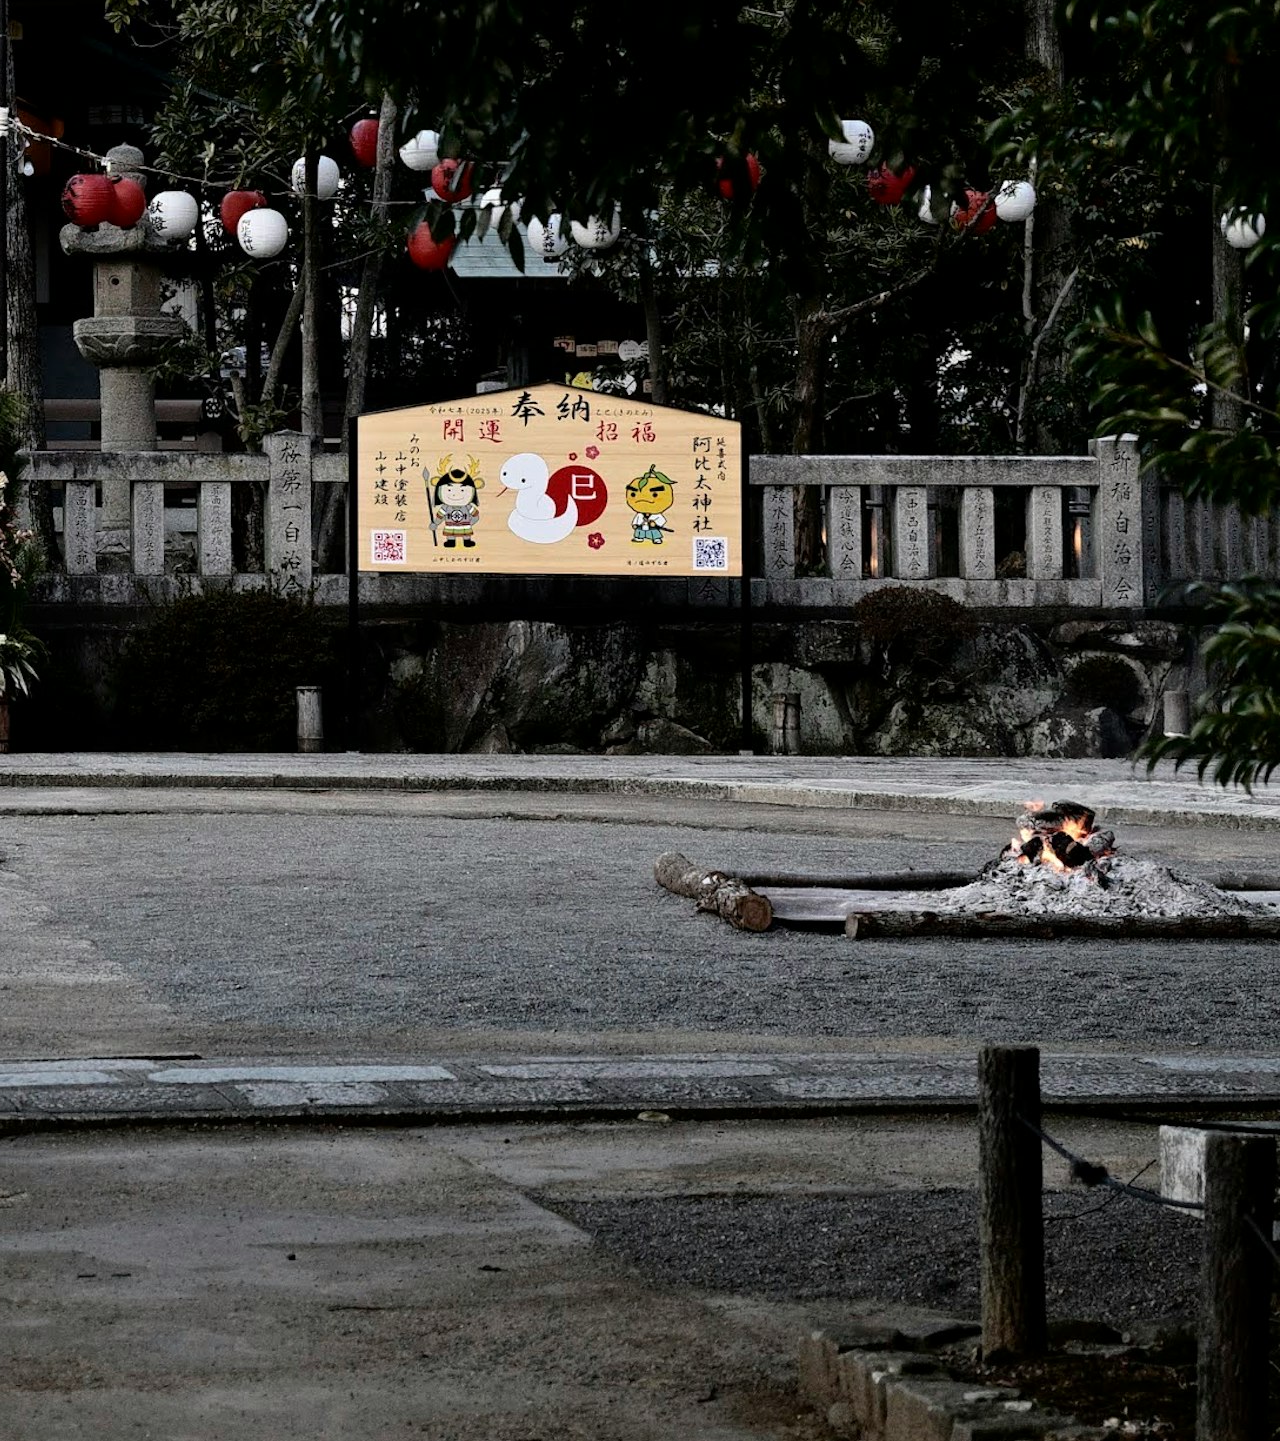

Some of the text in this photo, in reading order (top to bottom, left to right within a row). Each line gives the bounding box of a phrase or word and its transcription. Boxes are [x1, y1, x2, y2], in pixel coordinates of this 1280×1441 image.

[443, 419, 657, 443] 開運 招福
[510, 391, 591, 426] 奉納
[408, 433, 421, 469] みのお
[374, 450, 390, 507] 山中建設
[394, 450, 409, 523] 山中塗装店
[571, 473, 597, 501] 巳
[692, 436, 713, 533] 阿比太神社
[1110, 449, 1133, 601] 新稲自治会
